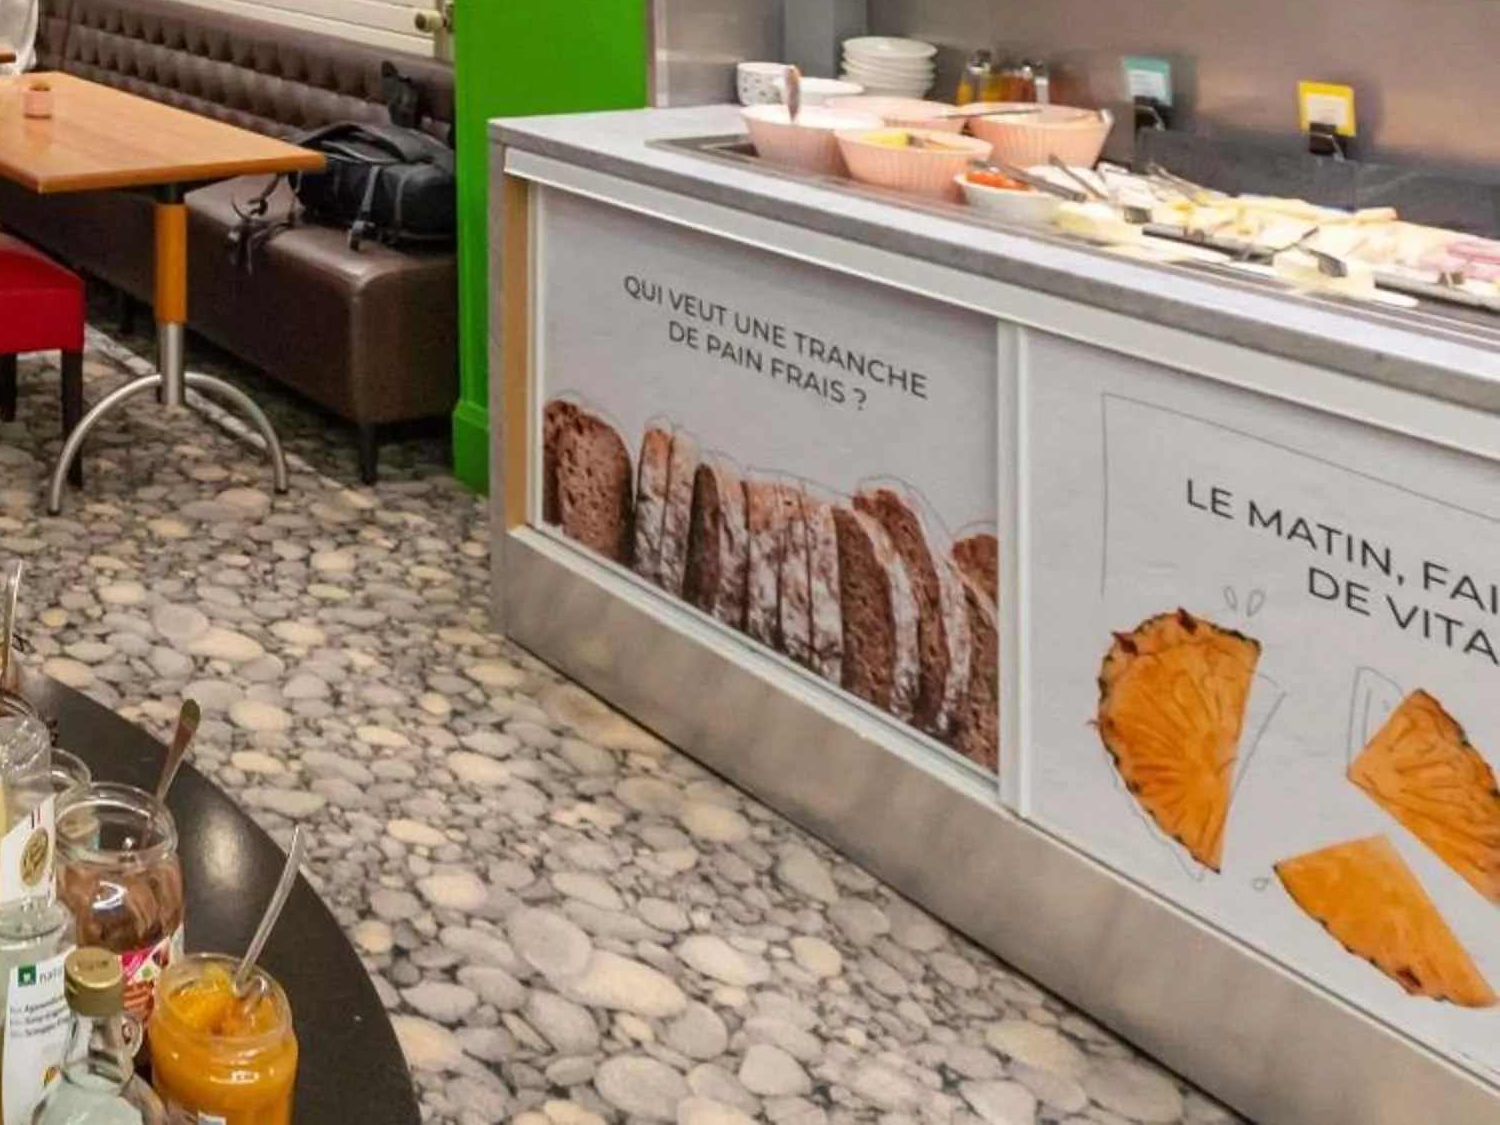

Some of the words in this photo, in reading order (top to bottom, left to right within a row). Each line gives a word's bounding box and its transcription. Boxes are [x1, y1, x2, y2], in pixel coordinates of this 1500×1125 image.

[623, 275, 663, 305] QUI
[668, 288, 728, 326] VEUT
[734, 311, 787, 349] UNE
[793, 331, 929, 400] TRANCHE
[668, 320, 700, 350] DE
[706, 333, 763, 374] PAIN
[771, 356, 847, 405] FRAIS
[852, 386, 868, 412] ?
[1186, 478, 1235, 520] LE
[1308, 566, 1371, 617] DE
[1386, 593, 1500, 666] VITA
